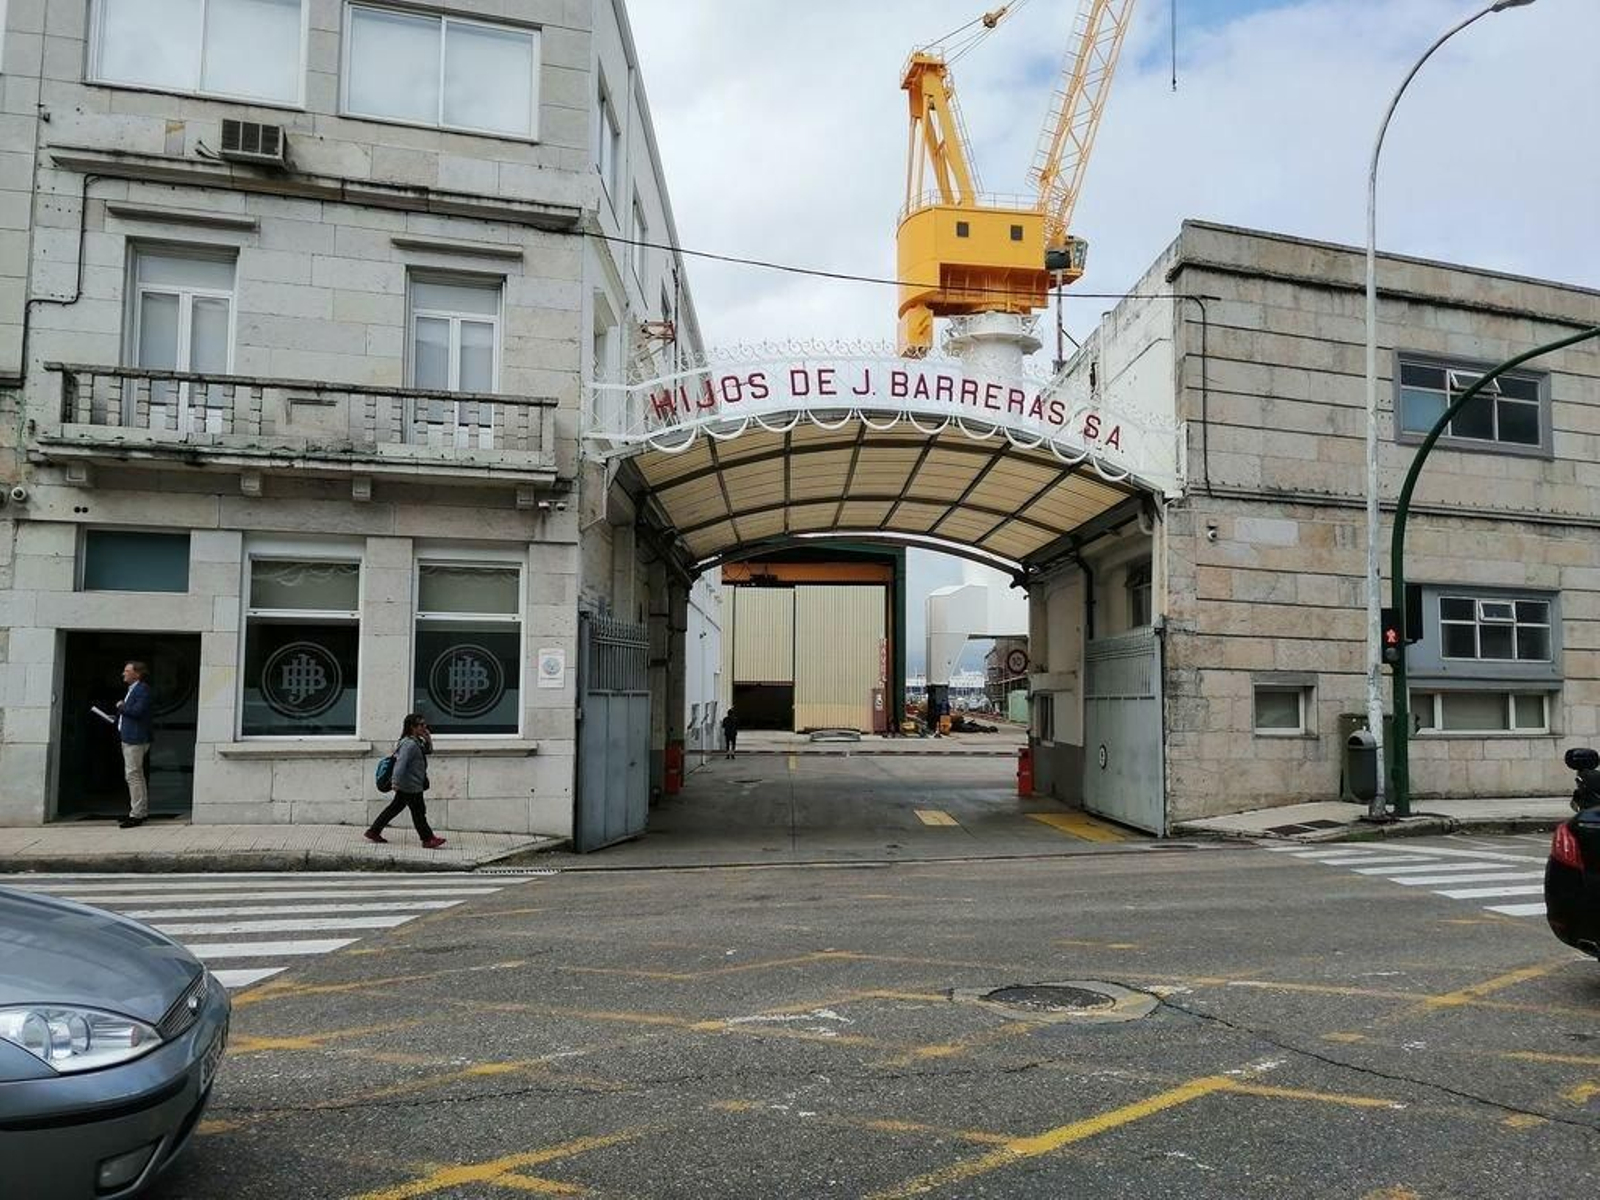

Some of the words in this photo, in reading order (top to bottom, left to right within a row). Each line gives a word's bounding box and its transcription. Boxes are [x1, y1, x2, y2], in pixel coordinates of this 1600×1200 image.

[650, 372, 769, 420] HIJOS
[790, 369, 837, 396] DE
[853, 369, 876, 396] J.
[891, 371, 1066, 426] BARRERAS
